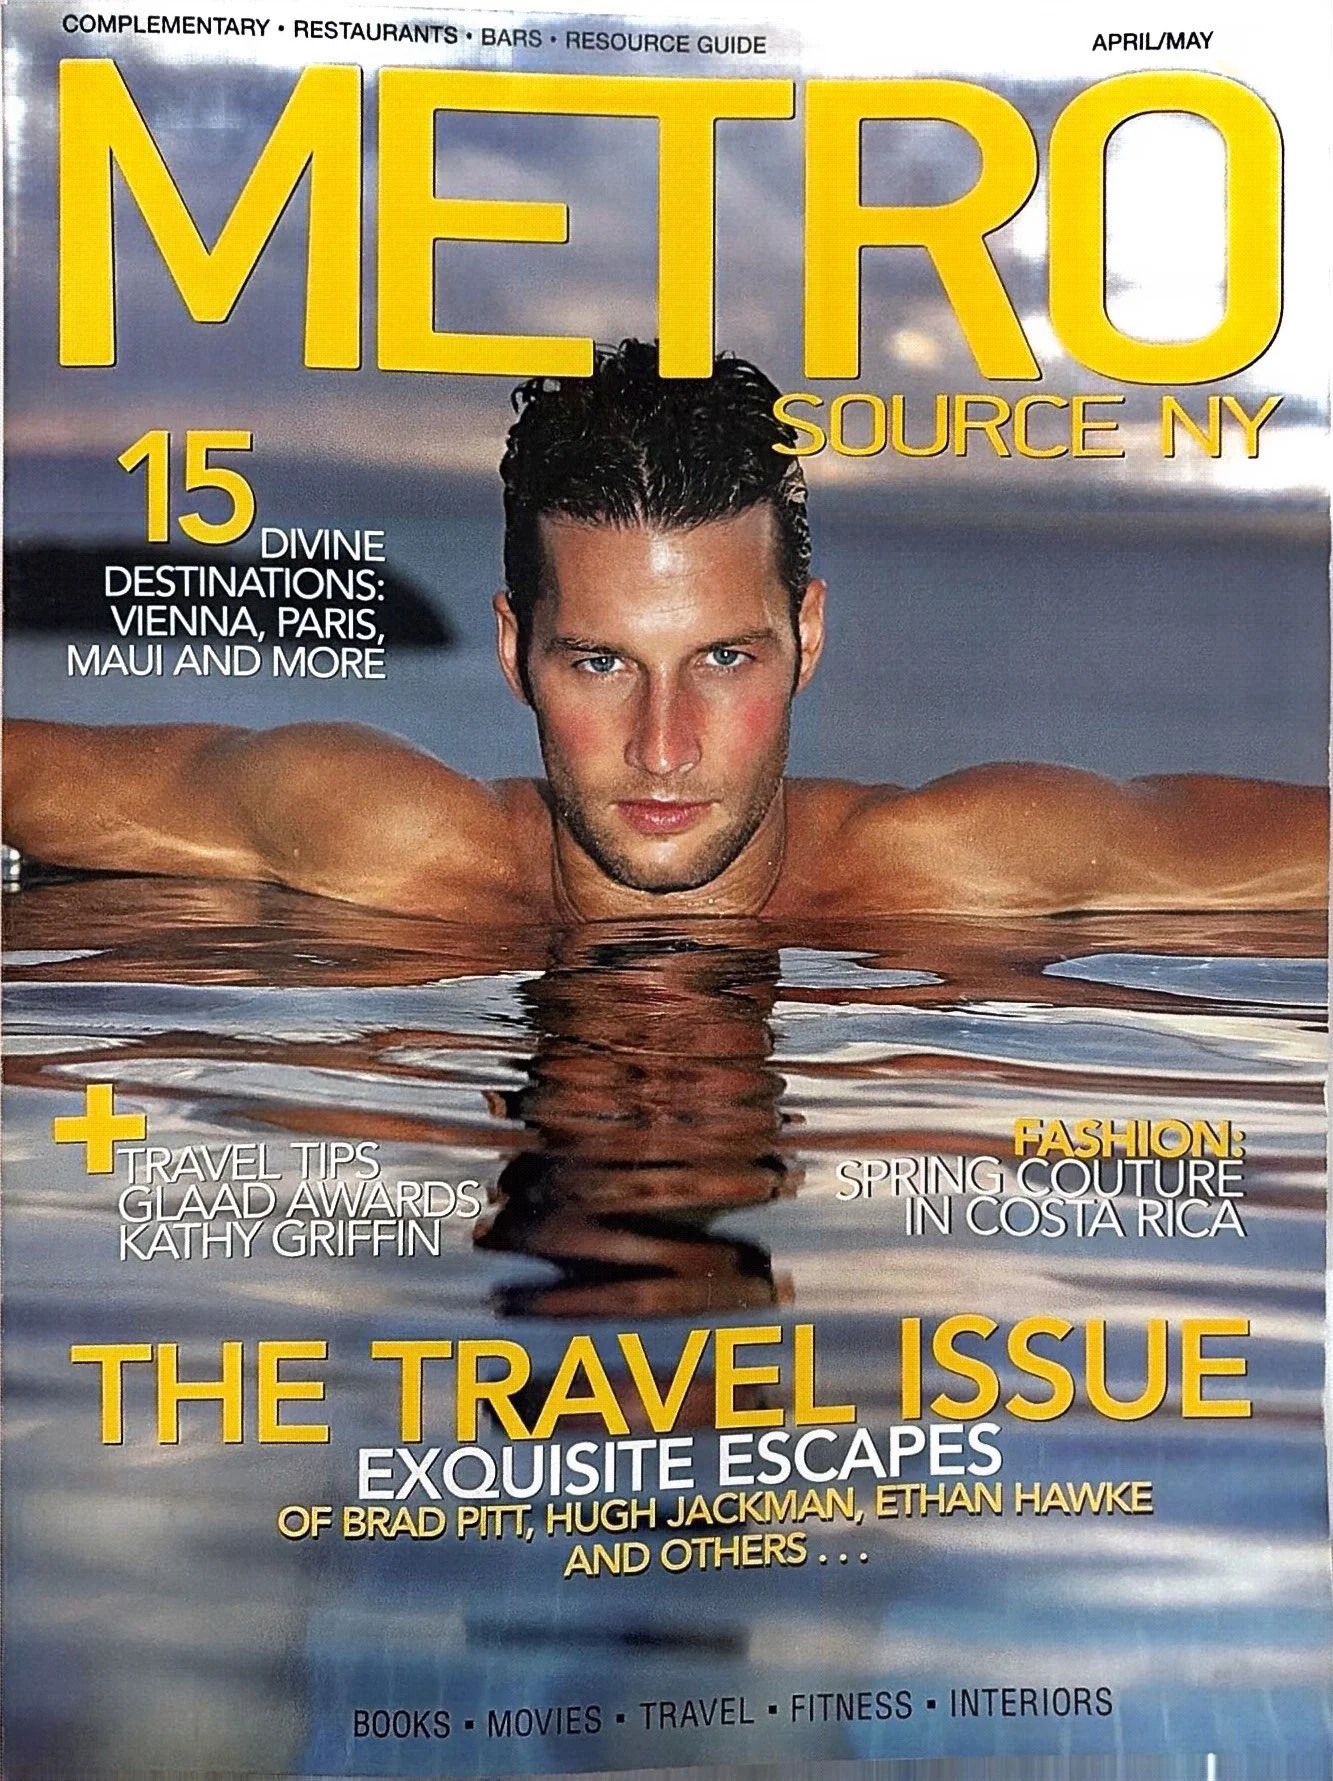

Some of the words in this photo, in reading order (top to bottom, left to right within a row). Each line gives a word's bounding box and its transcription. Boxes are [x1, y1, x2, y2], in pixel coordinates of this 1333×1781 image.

[62, 14, 270, 38] COMPLEMENTARY
[293, 20, 459, 45] RESTAURANTS
[481, 28, 543, 49] BARS
[565, 31, 690, 54] RESOURCE
[697, 33, 767, 55] GUIDE
[1092, 31, 1214, 52] APRIL/MAY
[58, 57, 1284, 386] METRO
[771, 392, 1125, 459] SOURCE
[1162, 394, 1285, 459] NY
[117, 429, 257, 545] 15
[261, 527, 386, 562] DIVINE
[104, 565, 386, 602] DESTINATIONS:
[110, 604, 266, 643] VIENNA,
[278, 607, 386, 645] PARIS,
[67, 645, 163, 677] MAUI
[173, 645, 261, 677] AND
[272, 647, 387, 680] MORE
[1012, 1118, 1247, 1158] FASHION:
[117, 1144, 282, 1185] TRAVEL
[289, 1141, 381, 1181] TIPS
[834, 1156, 1004, 1201] SPRING
[1016, 1157, 1246, 1199] COUTURE
[118, 1182, 276, 1225] GLAAD
[286, 1180, 482, 1220] AWARDS
[905, 1198, 952, 1237] IN
[966, 1197, 1126, 1238] COSTA
[1138, 1198, 1247, 1238] RICA
[119, 1221, 264, 1262] KATHY
[272, 1218, 442, 1257] GRIFFIN
[70, 1340, 330, 1446] THE
[370, 1324, 856, 1444] TRAVEL
[901, 1313, 1252, 1422] ISSUE
[358, 1435, 695, 1501] EXQUISITE
[718, 1421, 1003, 1487] ESCAPES
[278, 1506, 332, 1540] OF
[343, 1504, 445, 1539] BRAD
[457, 1503, 534, 1543] PITT,
[547, 1498, 658, 1536] HUGH
[667, 1486, 864, 1527] JACKMAN,
[876, 1483, 1001, 1518] ETHAN
[1015, 1480, 1153, 1515] HAWKE
[563, 1541, 650, 1579] AND
[353, 1709, 452, 1739] BOOKS
[487, 1704, 602, 1737] MOVIES
[640, 1696, 755, 1731] TRAVEL
[790, 1689, 913, 1723] FITNESS
[950, 1686, 1114, 1718] INTERIORS
